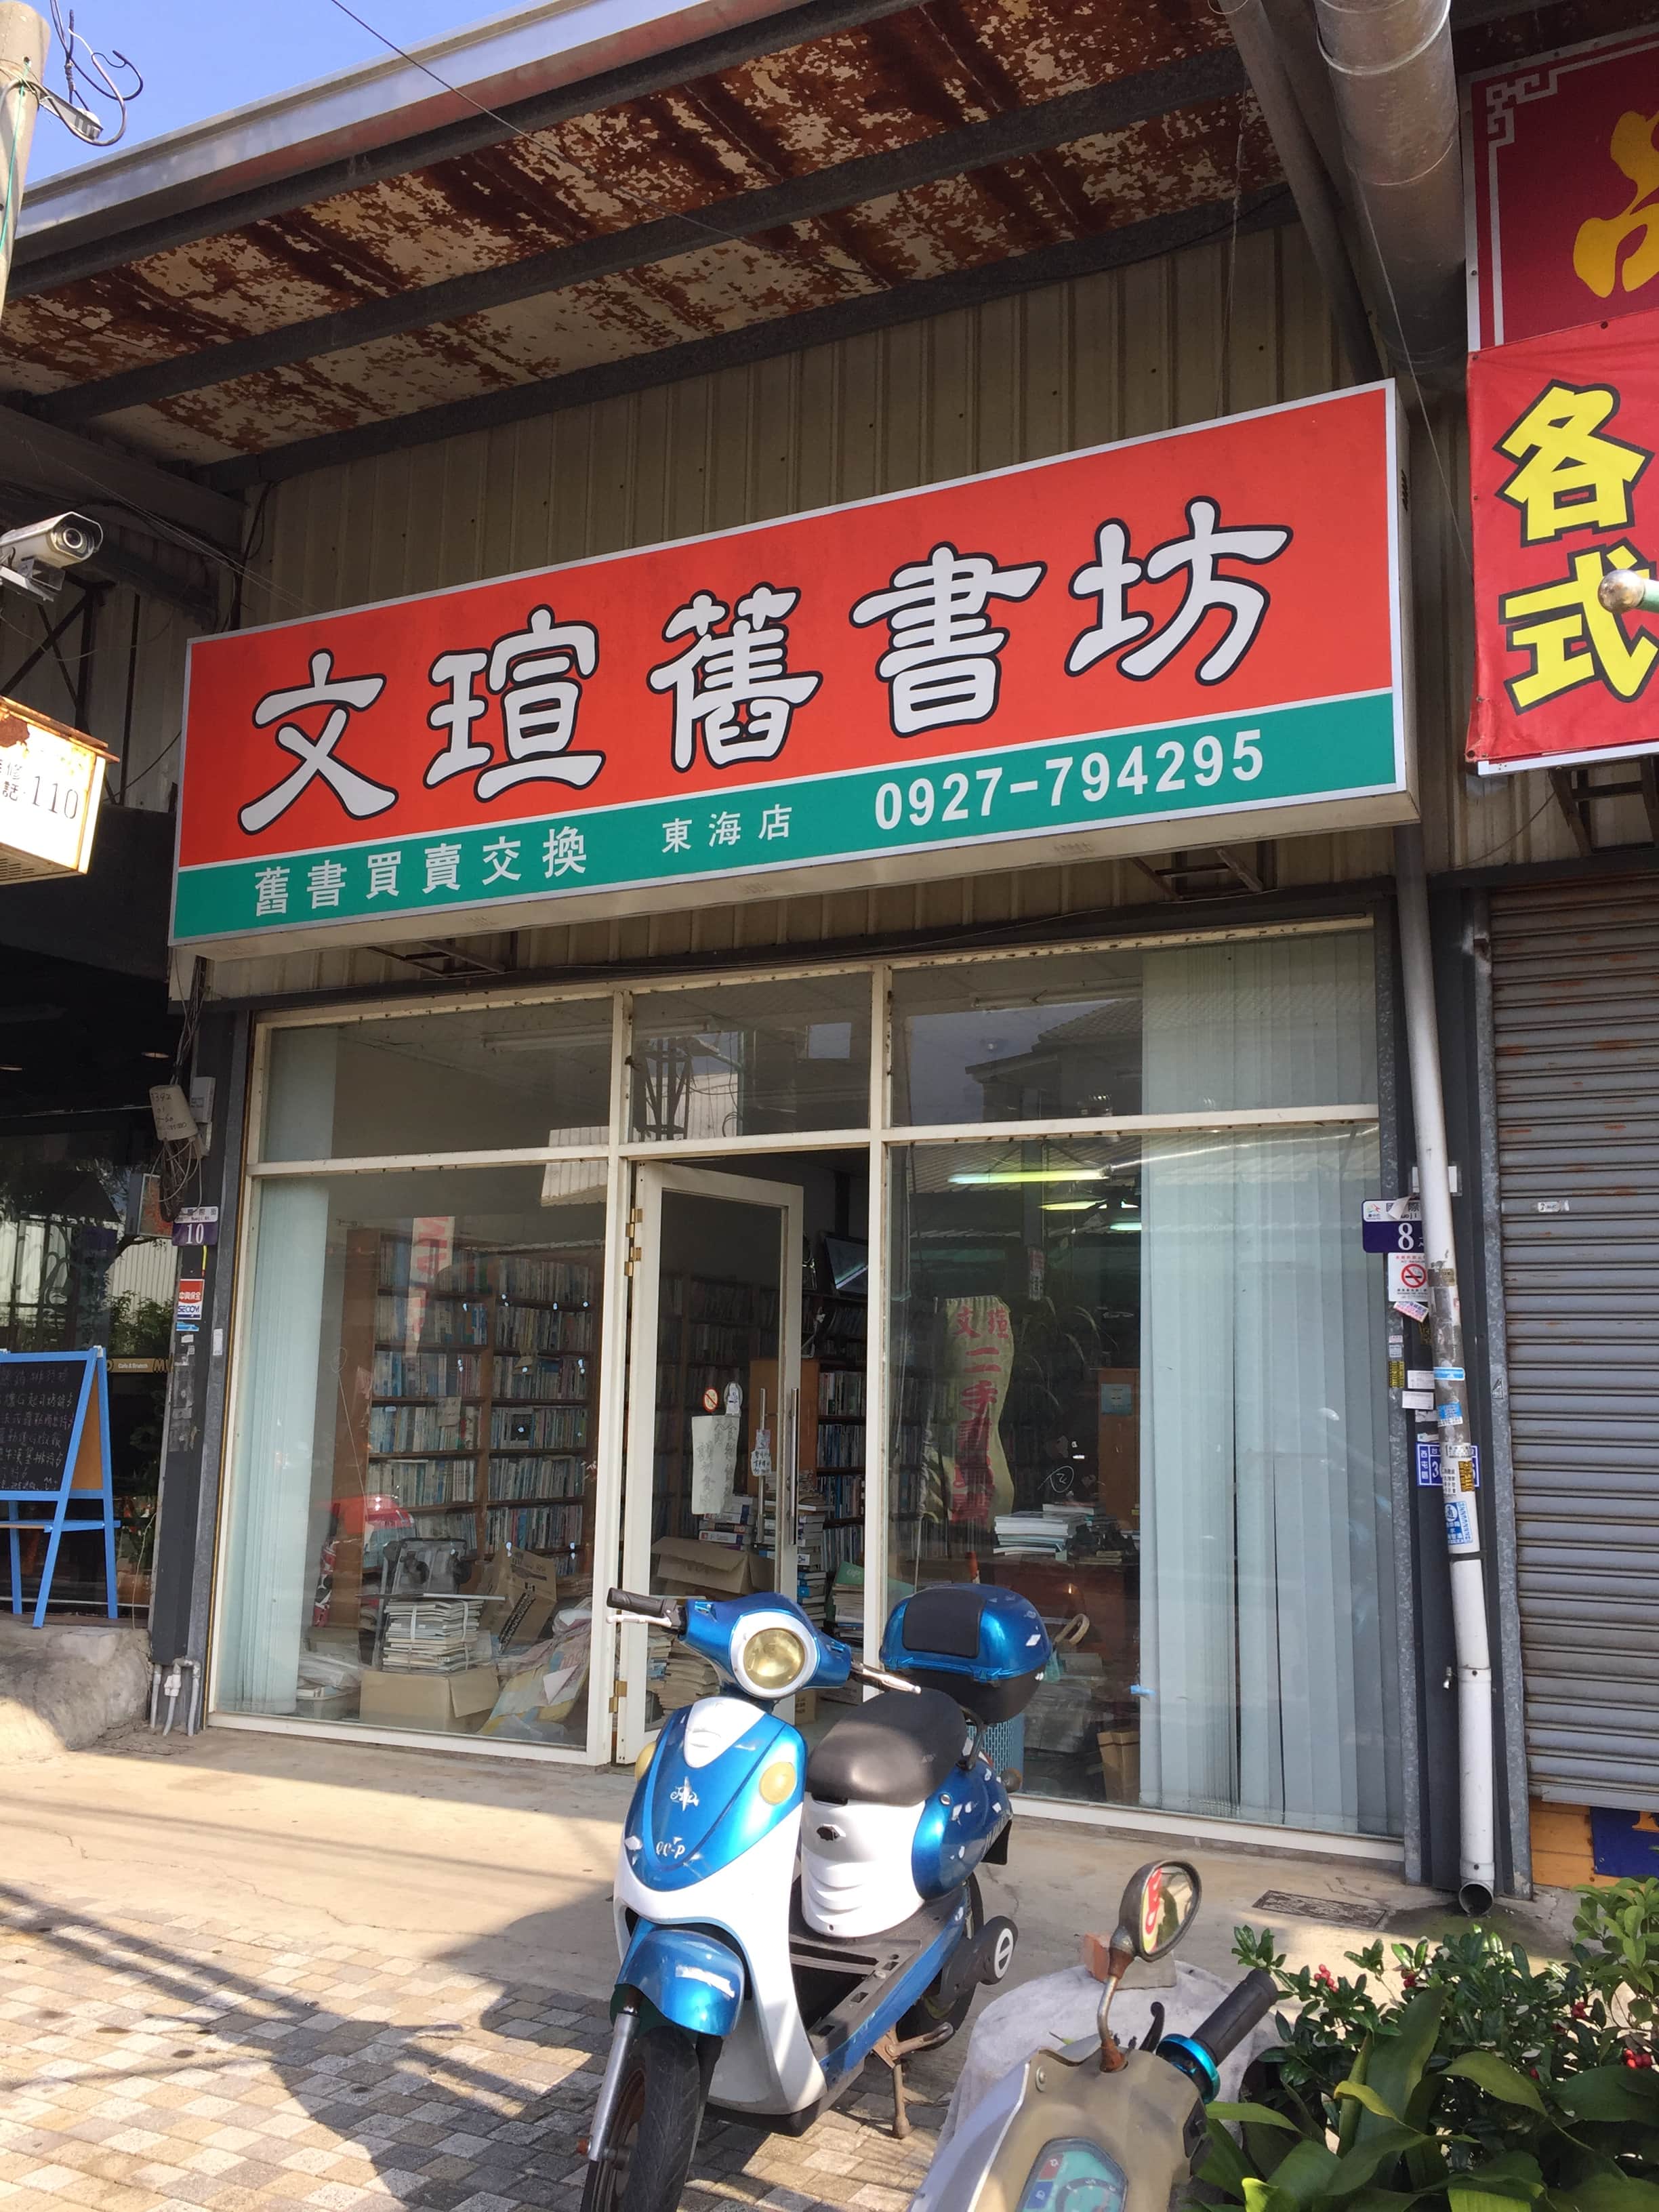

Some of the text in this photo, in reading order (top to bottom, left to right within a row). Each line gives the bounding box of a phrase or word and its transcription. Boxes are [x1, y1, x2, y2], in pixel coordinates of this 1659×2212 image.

[1493, 378, 1658, 716] 各式
[237, 495, 1294, 836] 文瑄舊書坊
[33, 776, 79, 819] 110
[875, 729, 1264, 830] 0927-794295
[255, 827, 587, 916] 舊書買賣交換
[662, 804, 792, 854] 東海店
[185, 1223, 204, 1244] 10
